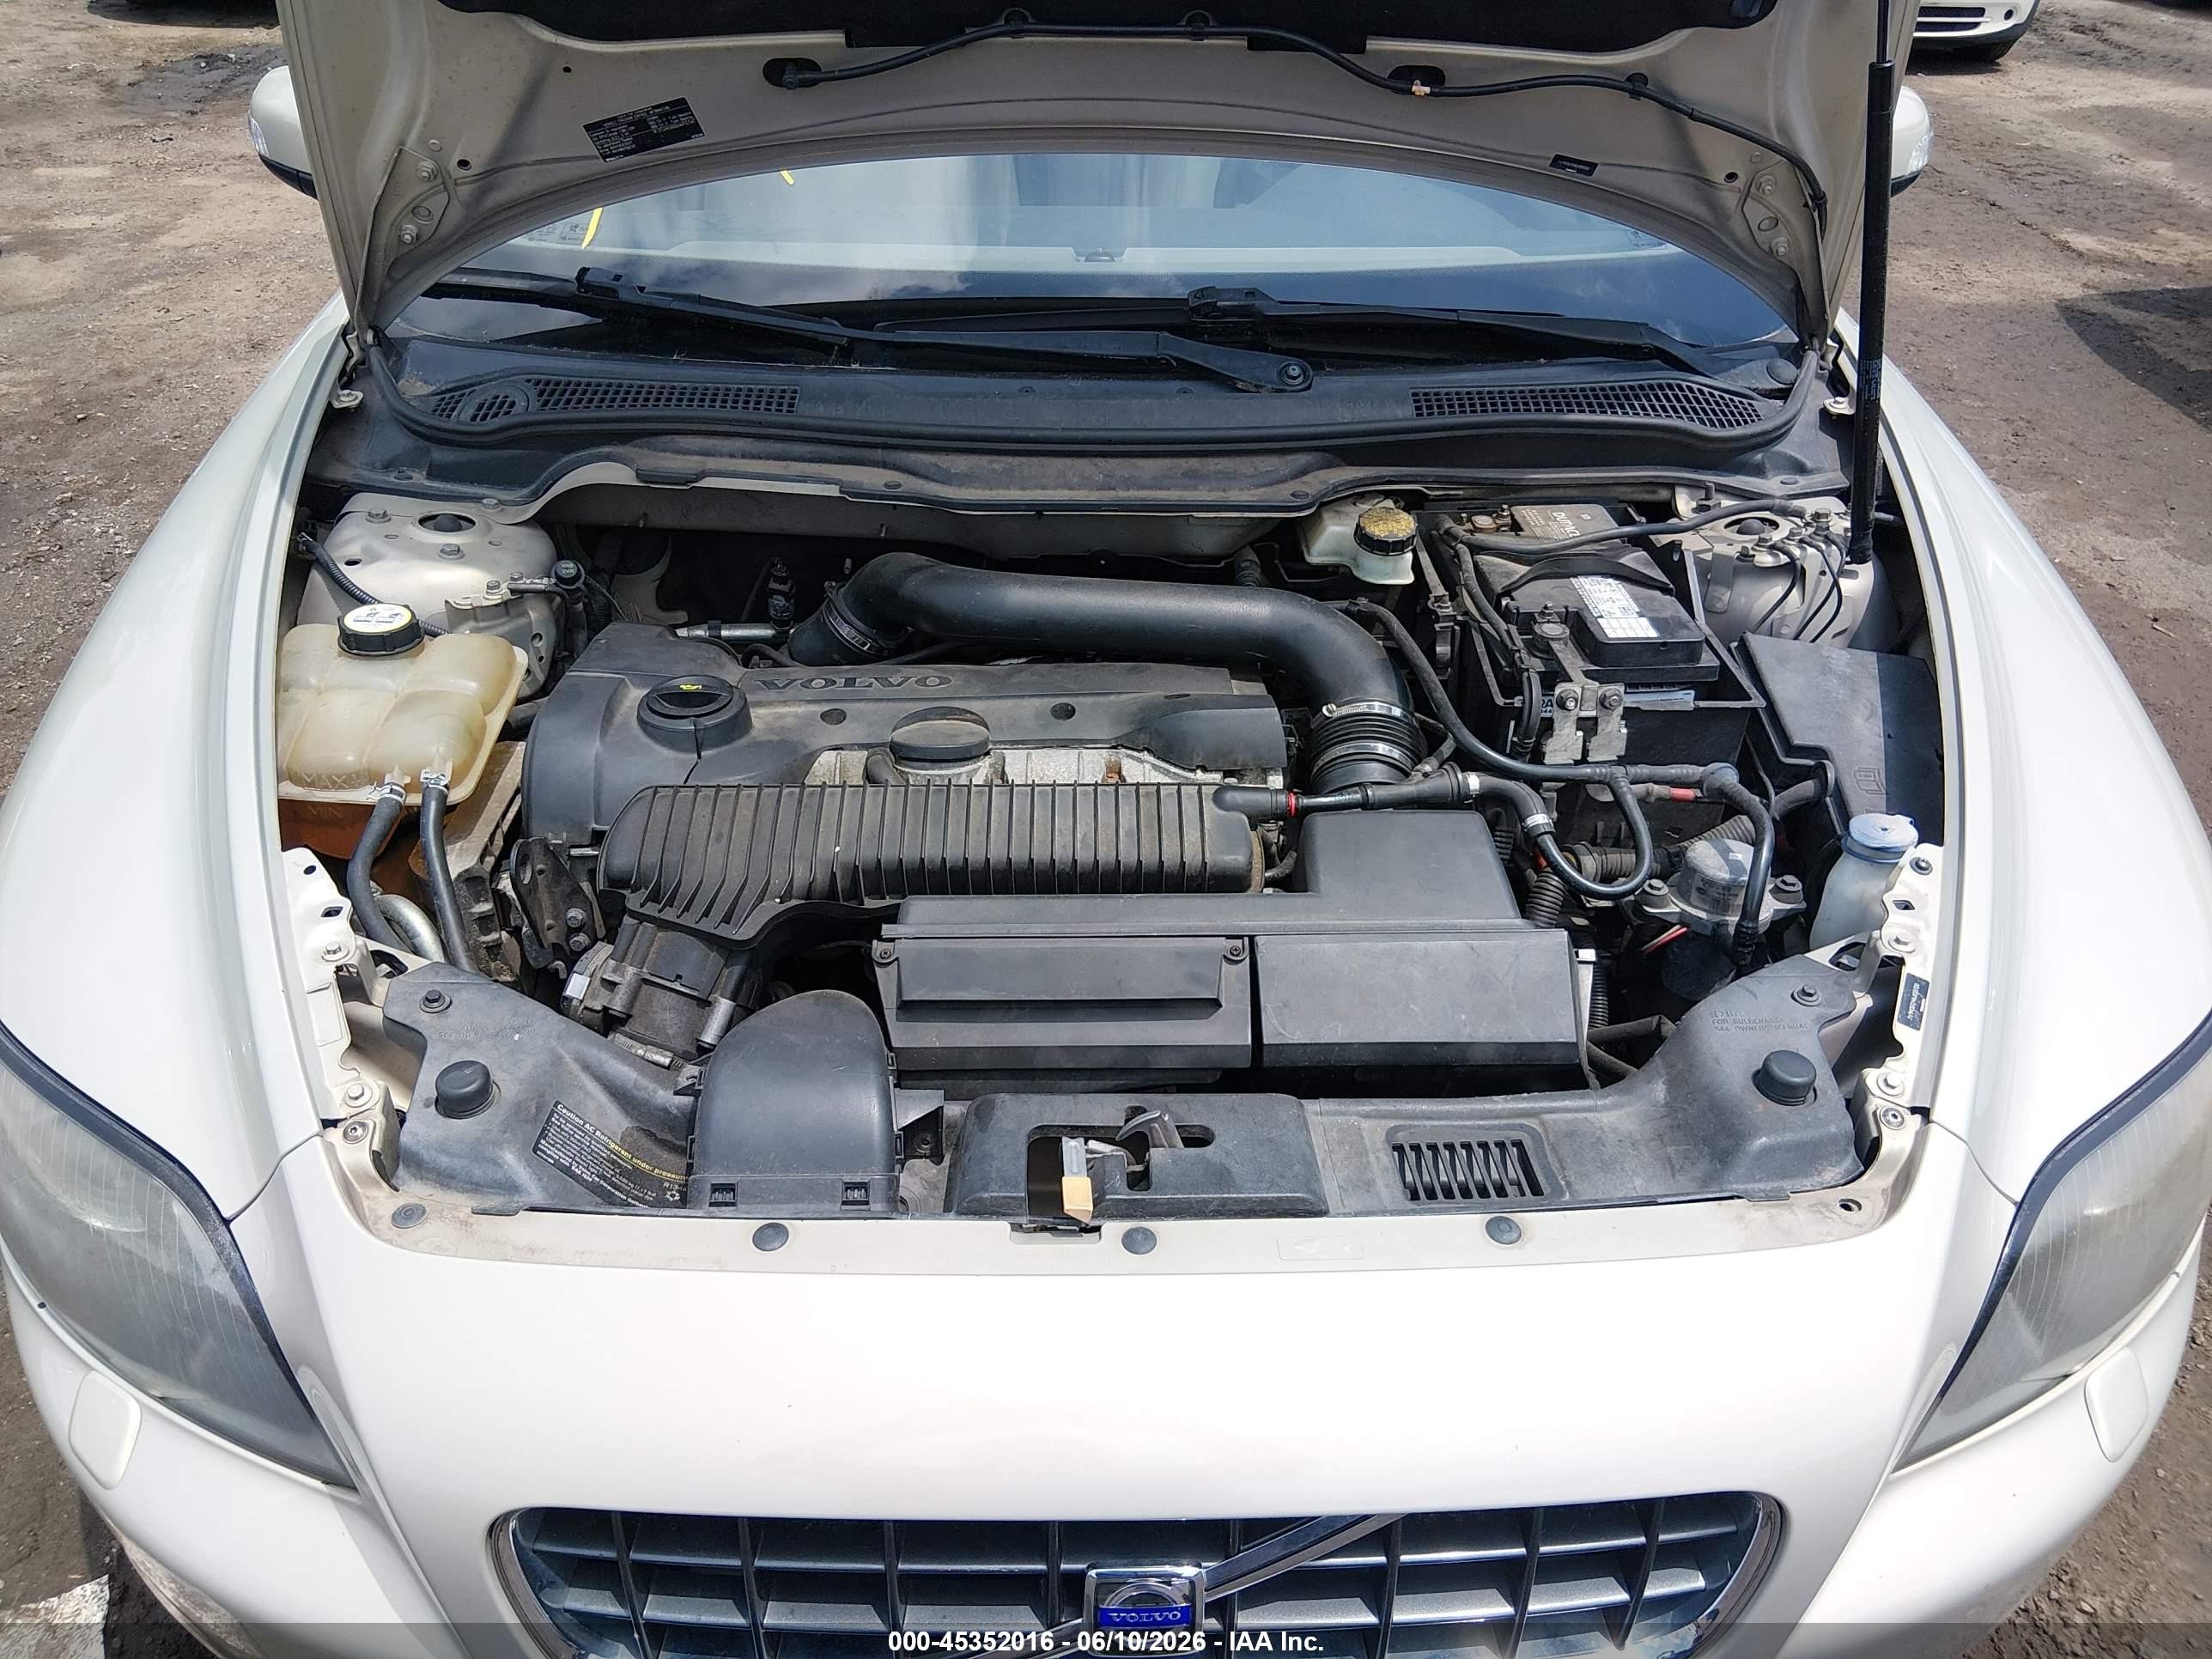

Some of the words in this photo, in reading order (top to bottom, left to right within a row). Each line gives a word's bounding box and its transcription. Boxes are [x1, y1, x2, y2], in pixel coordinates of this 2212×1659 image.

[754, 675, 952, 690] VOLVO
[301, 772, 349, 789] MAX
[557, 1104, 584, 1125] Caution
[583, 1122, 595, 1133] AC
[594, 1130, 632, 1159] Refrigerant
[632, 1156, 653, 1170] under
[653, 1167, 688, 1181] pressur
[1107, 1610, 1183, 1623] VOLVO
